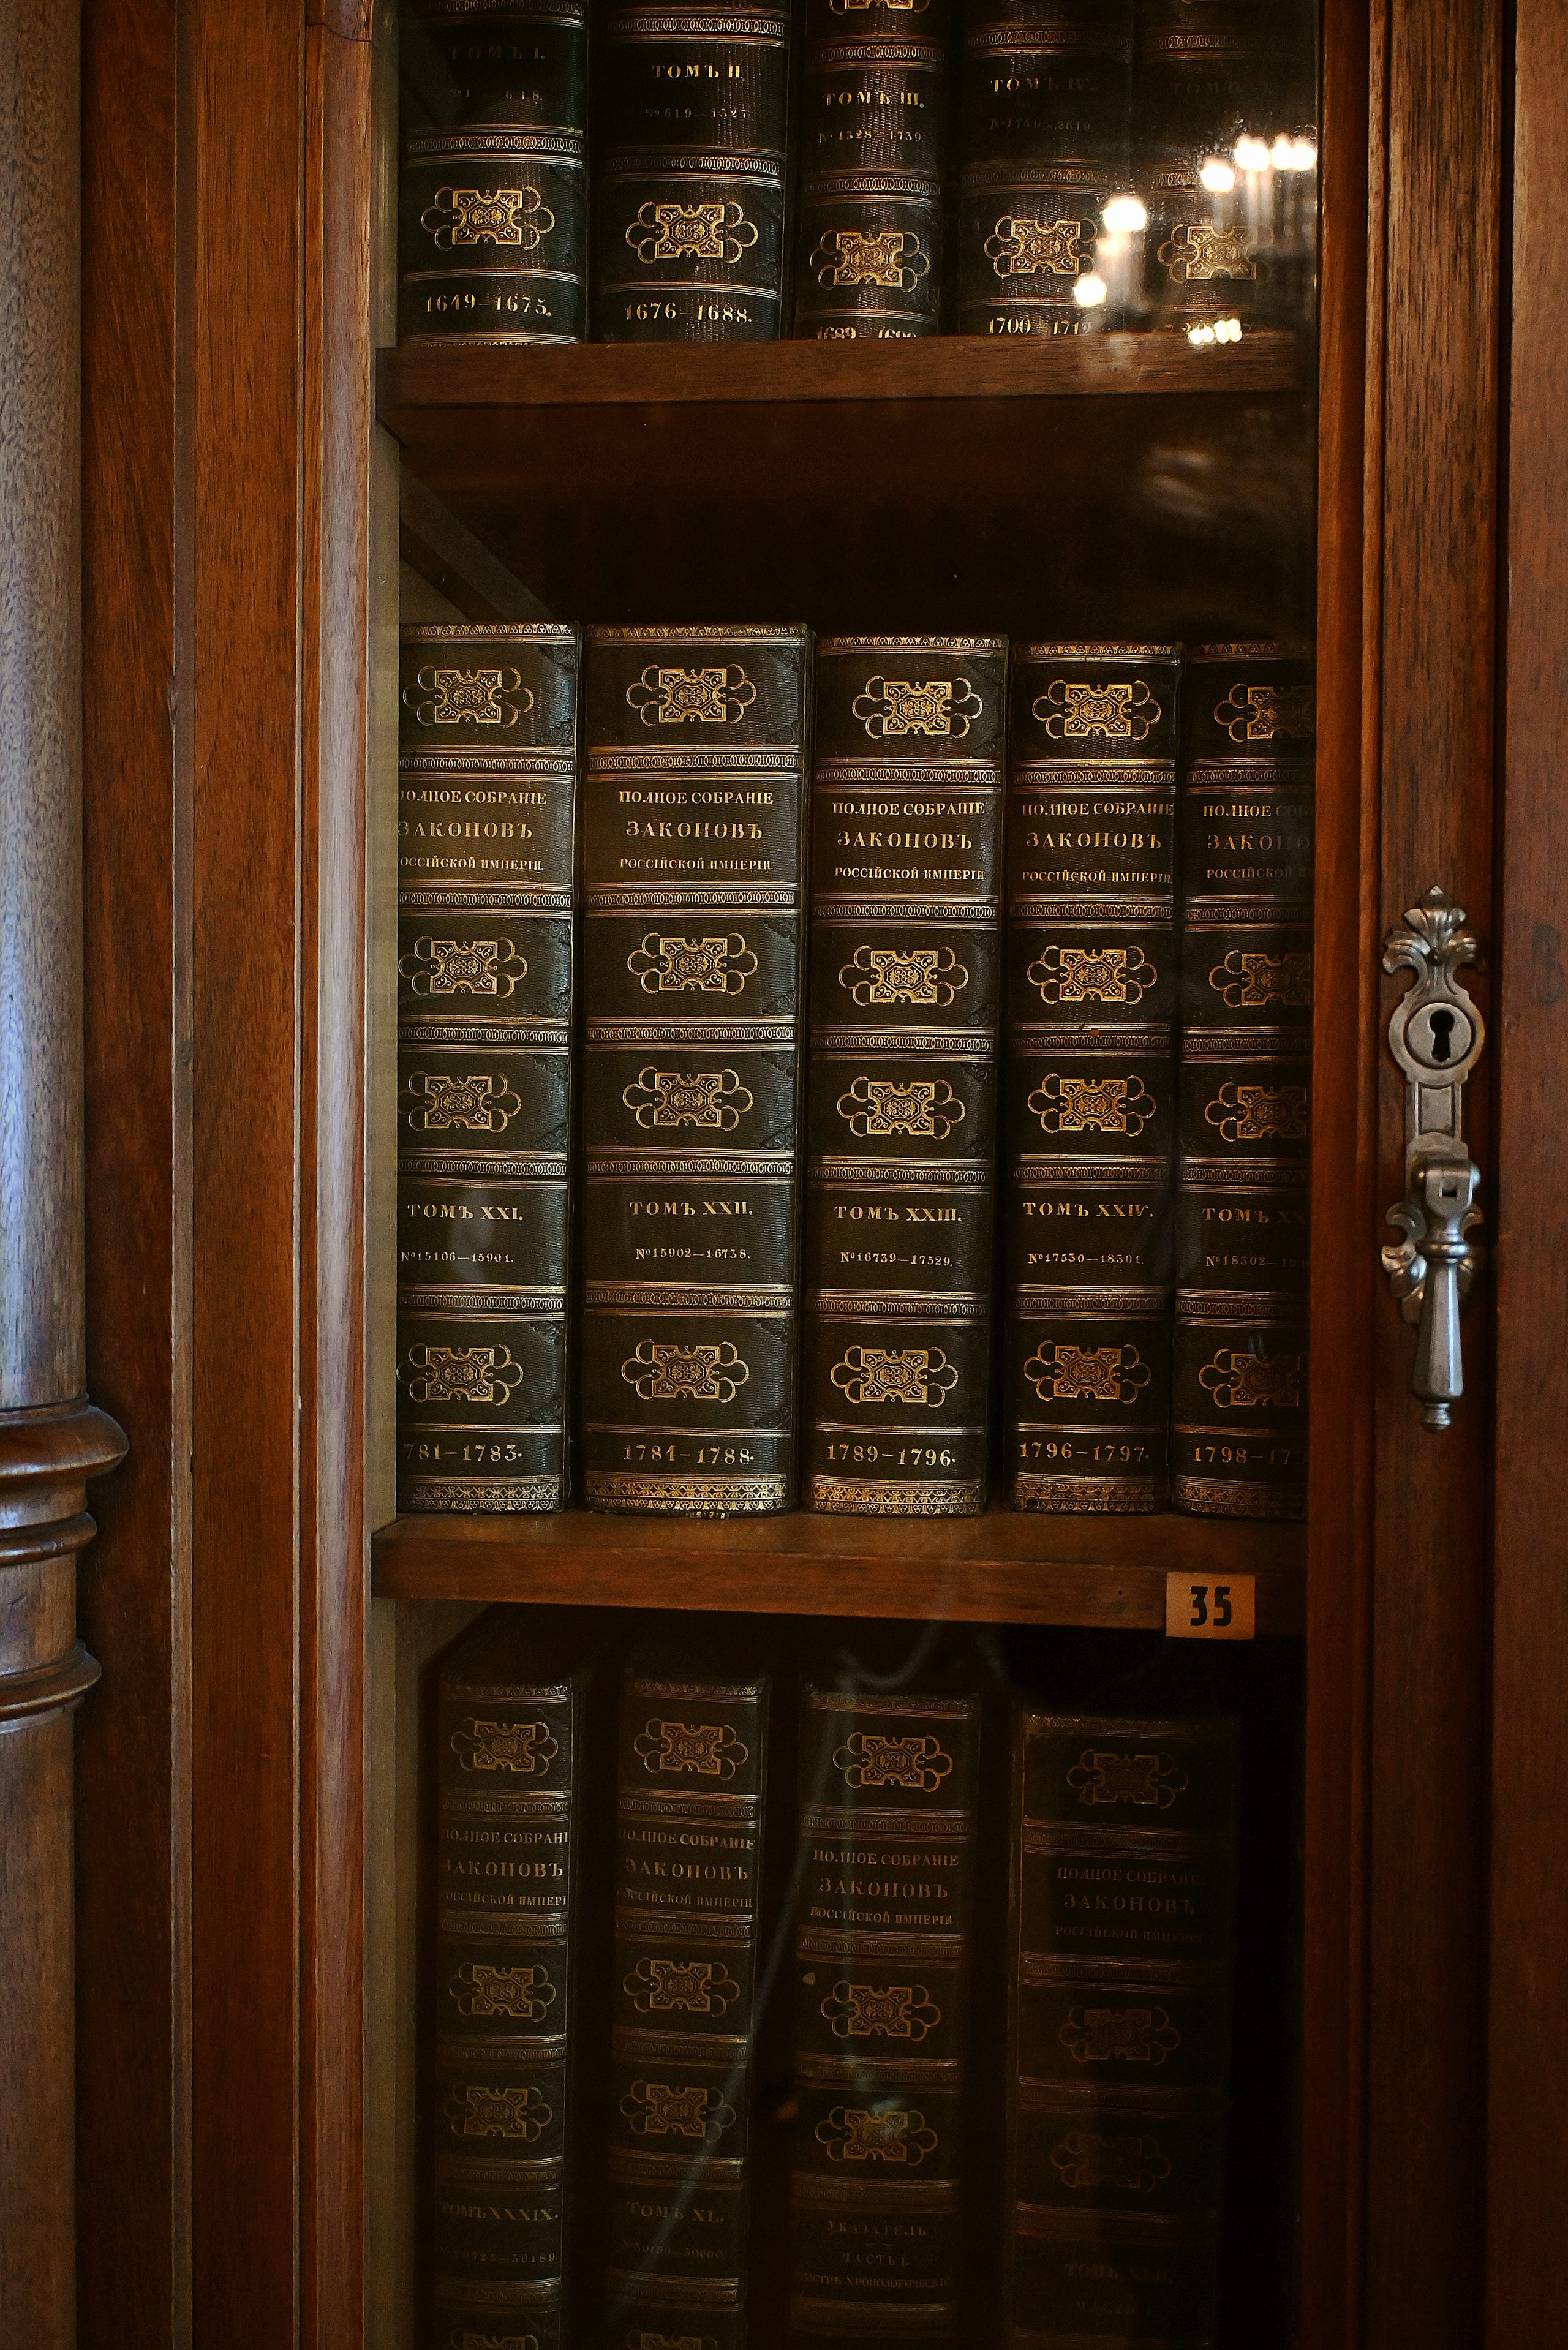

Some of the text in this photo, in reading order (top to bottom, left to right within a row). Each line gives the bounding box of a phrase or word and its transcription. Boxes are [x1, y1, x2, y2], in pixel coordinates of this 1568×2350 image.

[449, 45, 524, 60] ТОМЪ
[652, 64, 720, 78] ТОМЪ
[823, 92, 925, 108] ТОМЪ III.
[464, 790, 547, 805] СОБРАНІЕ
[619, 791, 773, 805] ПОЛНОЕ СОБРАНІЕ
[832, 802, 985, 815] ПОЛНОЕ СОБРАНІЕ
[1022, 802, 1174, 816] ПОЛНОЕ СОБРАНІЕ
[1203, 805, 1272, 817] ПОЛНОЕ
[398, 821, 532, 838] ЗАКОНОВЪ
[626, 821, 763, 840] ЗАКОНОВЪ
[837, 830, 972, 849] ЗАКОНОВЪ
[1026, 832, 1161, 849] ЗАКОНОВЪ
[620, 857, 704, 870] РОССІЙСКОЙ
[834, 866, 919, 879] РОССІЙСКОЙ
[1022, 870, 1106, 883] РОССІЙСКОЙ
[407, 1204, 524, 1221] ТОМЪ XXI.
[629, 1201, 753, 1215] ТОМЪ XXII.
[834, 1205, 962, 1222] ТОМЪ XXIII.
[1023, 1202, 1153, 1218] ТОМЪ XXIV.
[1202, 1208, 1270, 1224] ТОМЪ
[827, 1444, 956, 1467] 1789–1796.
[1020, 1442, 1150, 1463] 1796–1797.
[1190, 1586, 1231, 1626] 35
[617, 1828, 756, 1850] ПОЛНОЕ СОБРАНІЕ
[813, 1849, 960, 1866] ПОЛНОЕ СОБРАНІЕ
[625, 1857, 748, 1880] ЗАКОНОВЪ
[1057, 1867, 1123, 1881] ПОЛНОЕ
[820, 1878, 948, 1899] ЗАКОНОВЪ
[1064, 1893, 1194, 1914] ЗАКОНОВЪ
[627, 2201, 684, 2220] ТОМЪ
